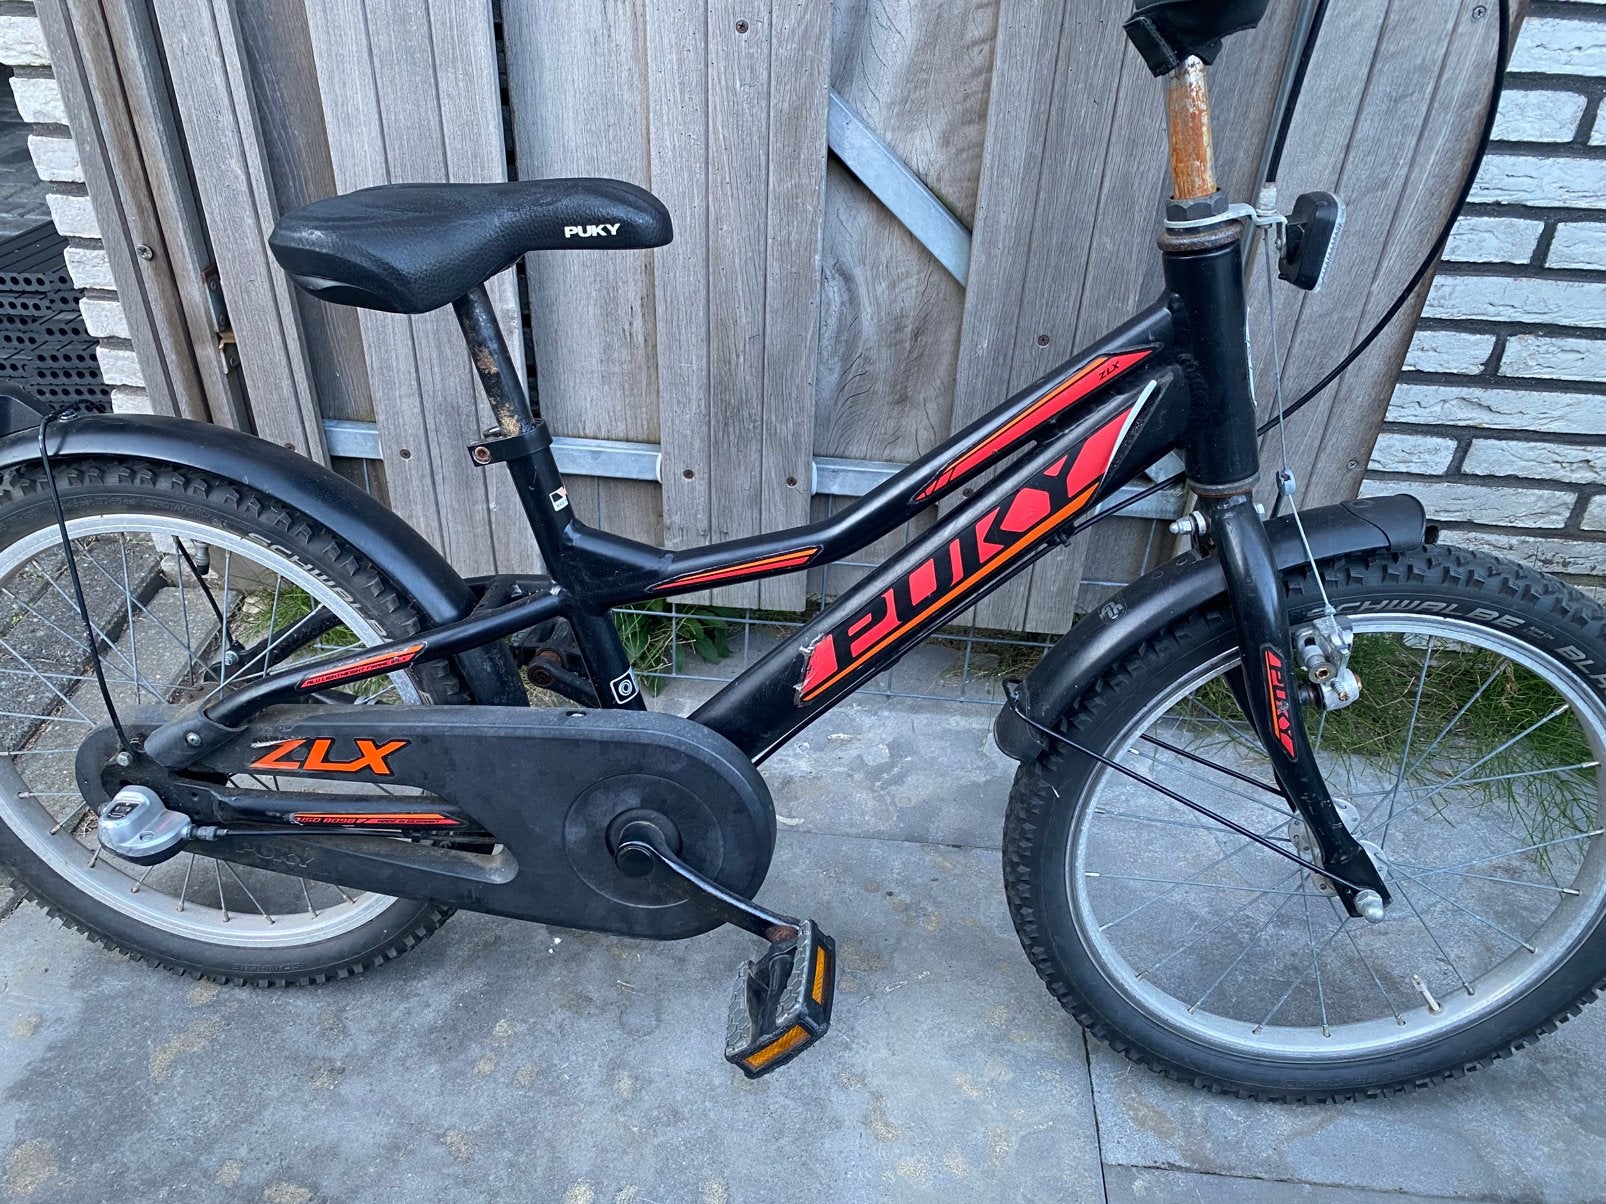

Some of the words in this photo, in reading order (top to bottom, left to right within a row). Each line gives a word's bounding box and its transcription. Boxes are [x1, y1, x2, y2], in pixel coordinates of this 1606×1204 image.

[563, 223, 620, 238] PUKY
[1098, 360, 1120, 381] ZLX
[829, 435, 1088, 670] PUKY
[1307, 599, 1526, 630] SCHWALBE
[248, 738, 407, 775] ZLX
[301, 816, 321, 824] ISO
